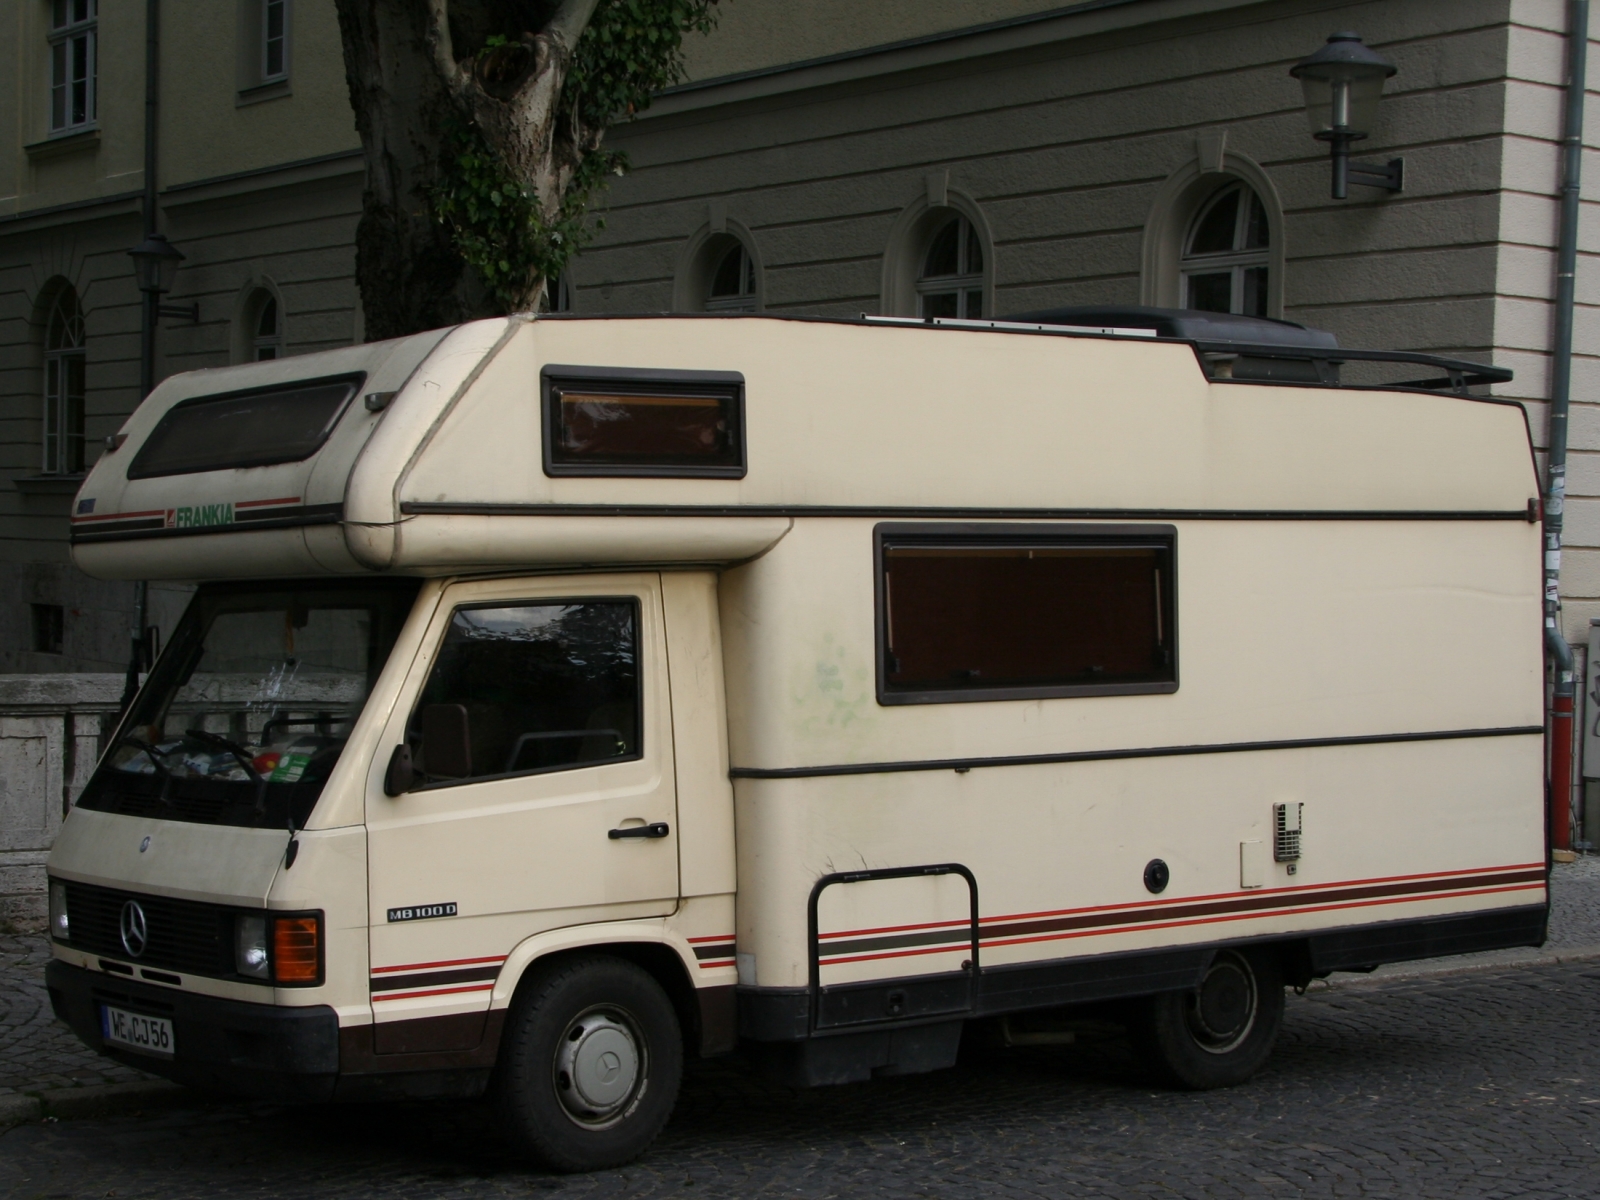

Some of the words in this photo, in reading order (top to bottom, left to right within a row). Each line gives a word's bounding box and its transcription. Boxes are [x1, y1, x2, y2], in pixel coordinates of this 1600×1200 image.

[176, 503, 233, 528] FRANKIA
[390, 909, 412, 920] MB
[416, 906, 443, 917] 100
[446, 904, 456, 914] D
[111, 1010, 127, 1040] WE
